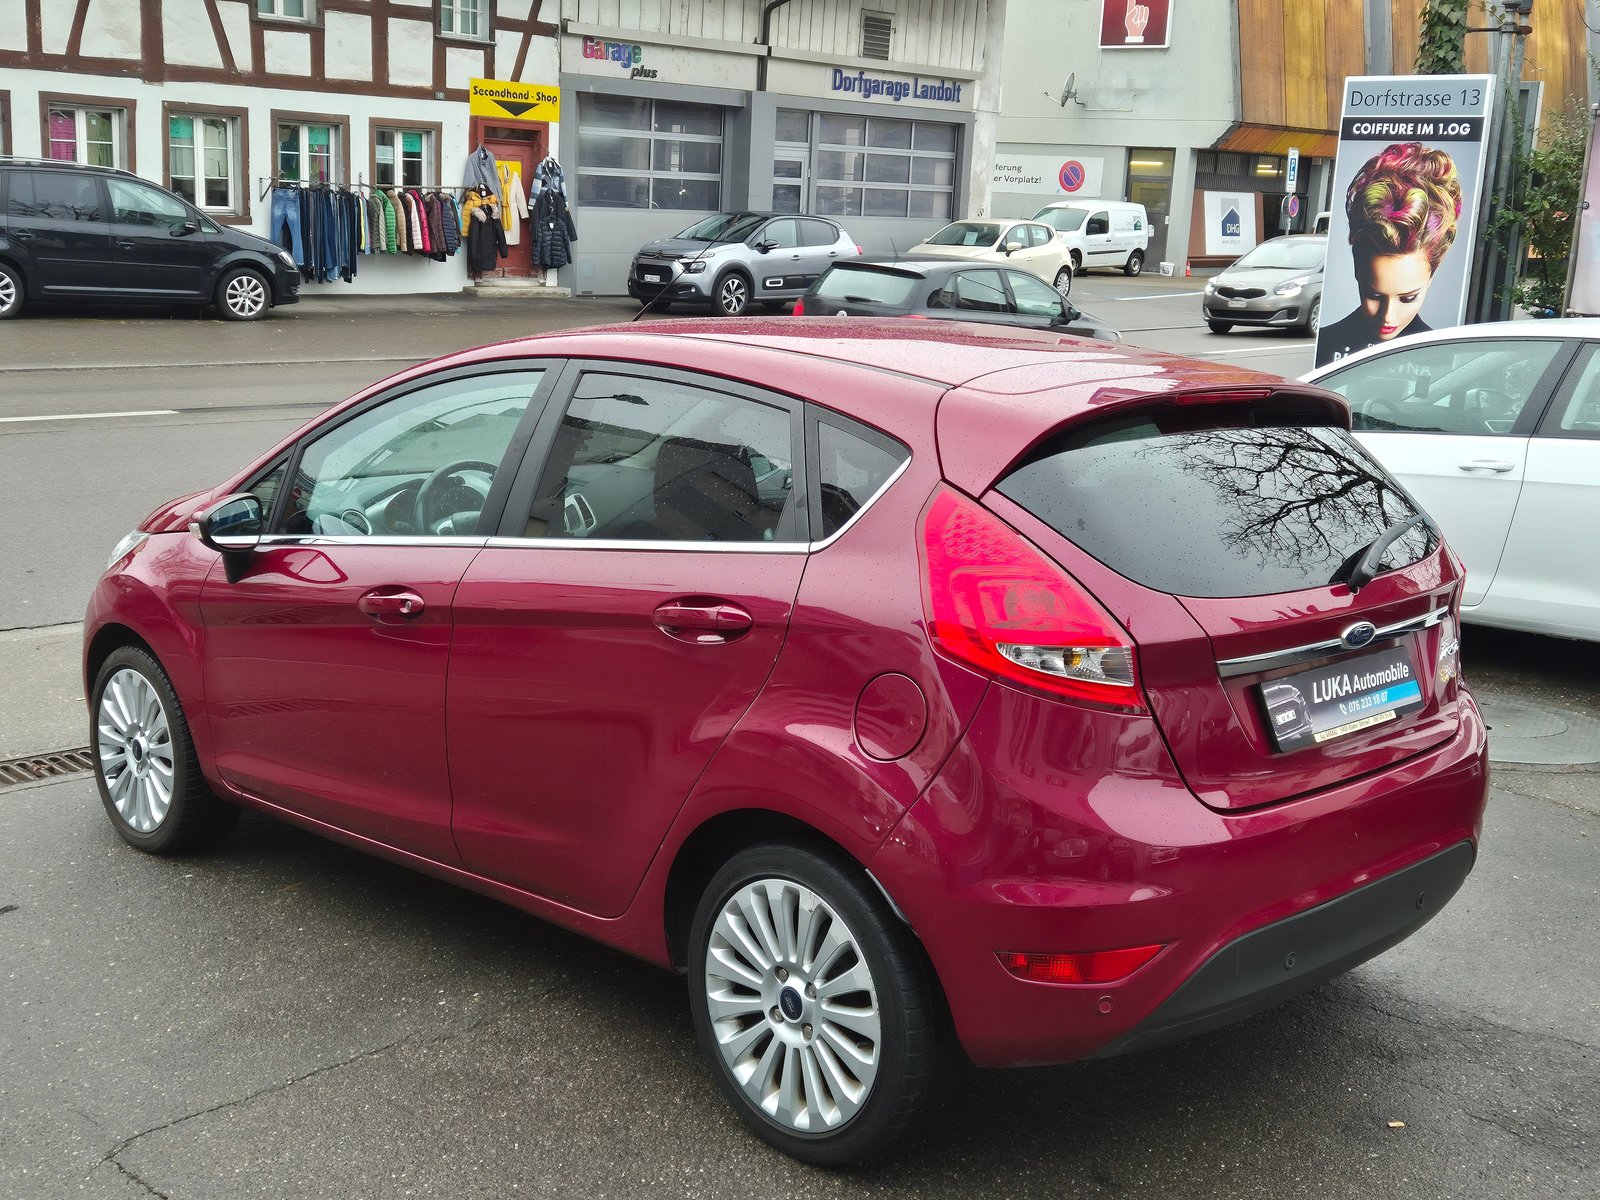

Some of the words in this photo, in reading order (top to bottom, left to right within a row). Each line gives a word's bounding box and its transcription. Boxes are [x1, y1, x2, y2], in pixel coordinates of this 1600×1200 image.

[582, 35, 642, 69] Garage
[630, 65, 658, 79] plus
[832, 68, 910, 101] Dorfgarage
[913, 78, 962, 103] Landolt
[473, 85, 529, 100] Secondhand
[536, 92, 558, 106] Shop
[1350, 89, 1452, 107] Dorfstrasse
[1460, 89, 1481, 106] 13
[1352, 123, 1415, 135] COIFFURE
[1417, 123, 1434, 135] IM
[1438, 123, 1471, 135] 1.OG
[995, 163, 1022, 173] ferung
[1004, 175, 1042, 184] Vorplatz!
[1226, 223, 1240, 234] DHG
[1313, 674, 1353, 704] LUKA
[1353, 662, 1409, 693] Automobile
[1348, 700, 1360, 713] 076
[1360, 697, 1372, 710] 233
[1372, 694, 1380, 705] 18
[1380, 691, 1388, 703] 07
